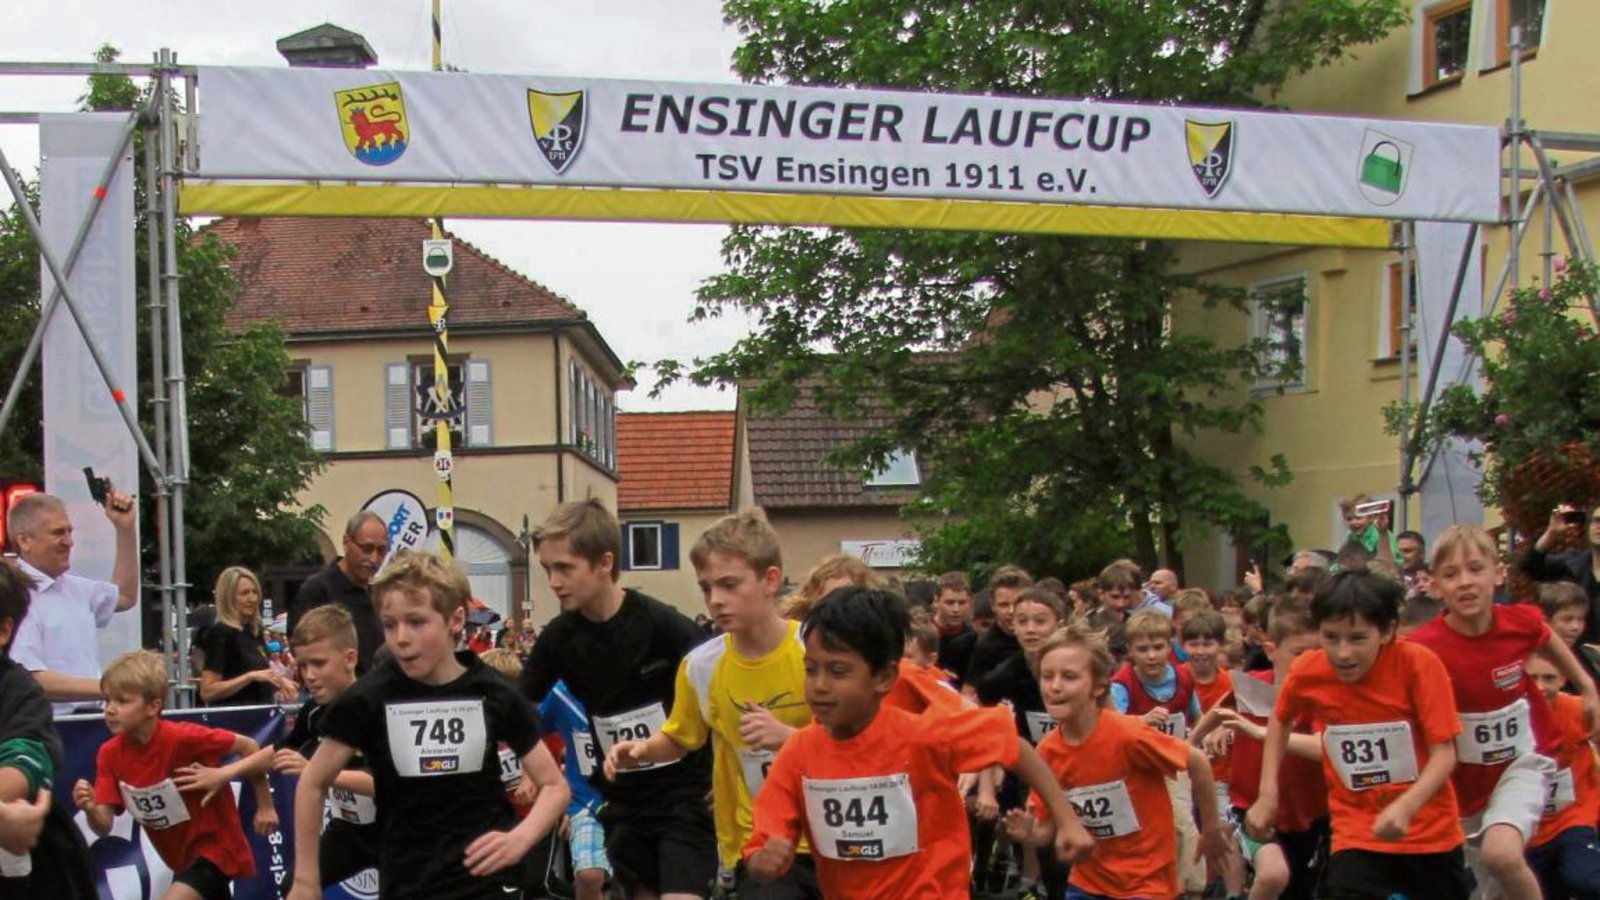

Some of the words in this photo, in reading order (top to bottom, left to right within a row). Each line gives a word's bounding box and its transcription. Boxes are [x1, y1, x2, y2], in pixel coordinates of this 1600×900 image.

[621, 94, 903, 143] ENSINGER
[922, 106, 1151, 153] LAUFCUP
[695, 153, 763, 182] TSV
[776, 157, 931, 191] Ensingen
[945, 163, 1024, 191] 1911
[1037, 168, 1097, 194] e.V.
[410, 717, 465, 747] 748
[1474, 717, 1519, 744] 616
[1341, 738, 1389, 764] 831
[823, 795, 889, 828] 844
[860, 845, 880, 855] GLS
